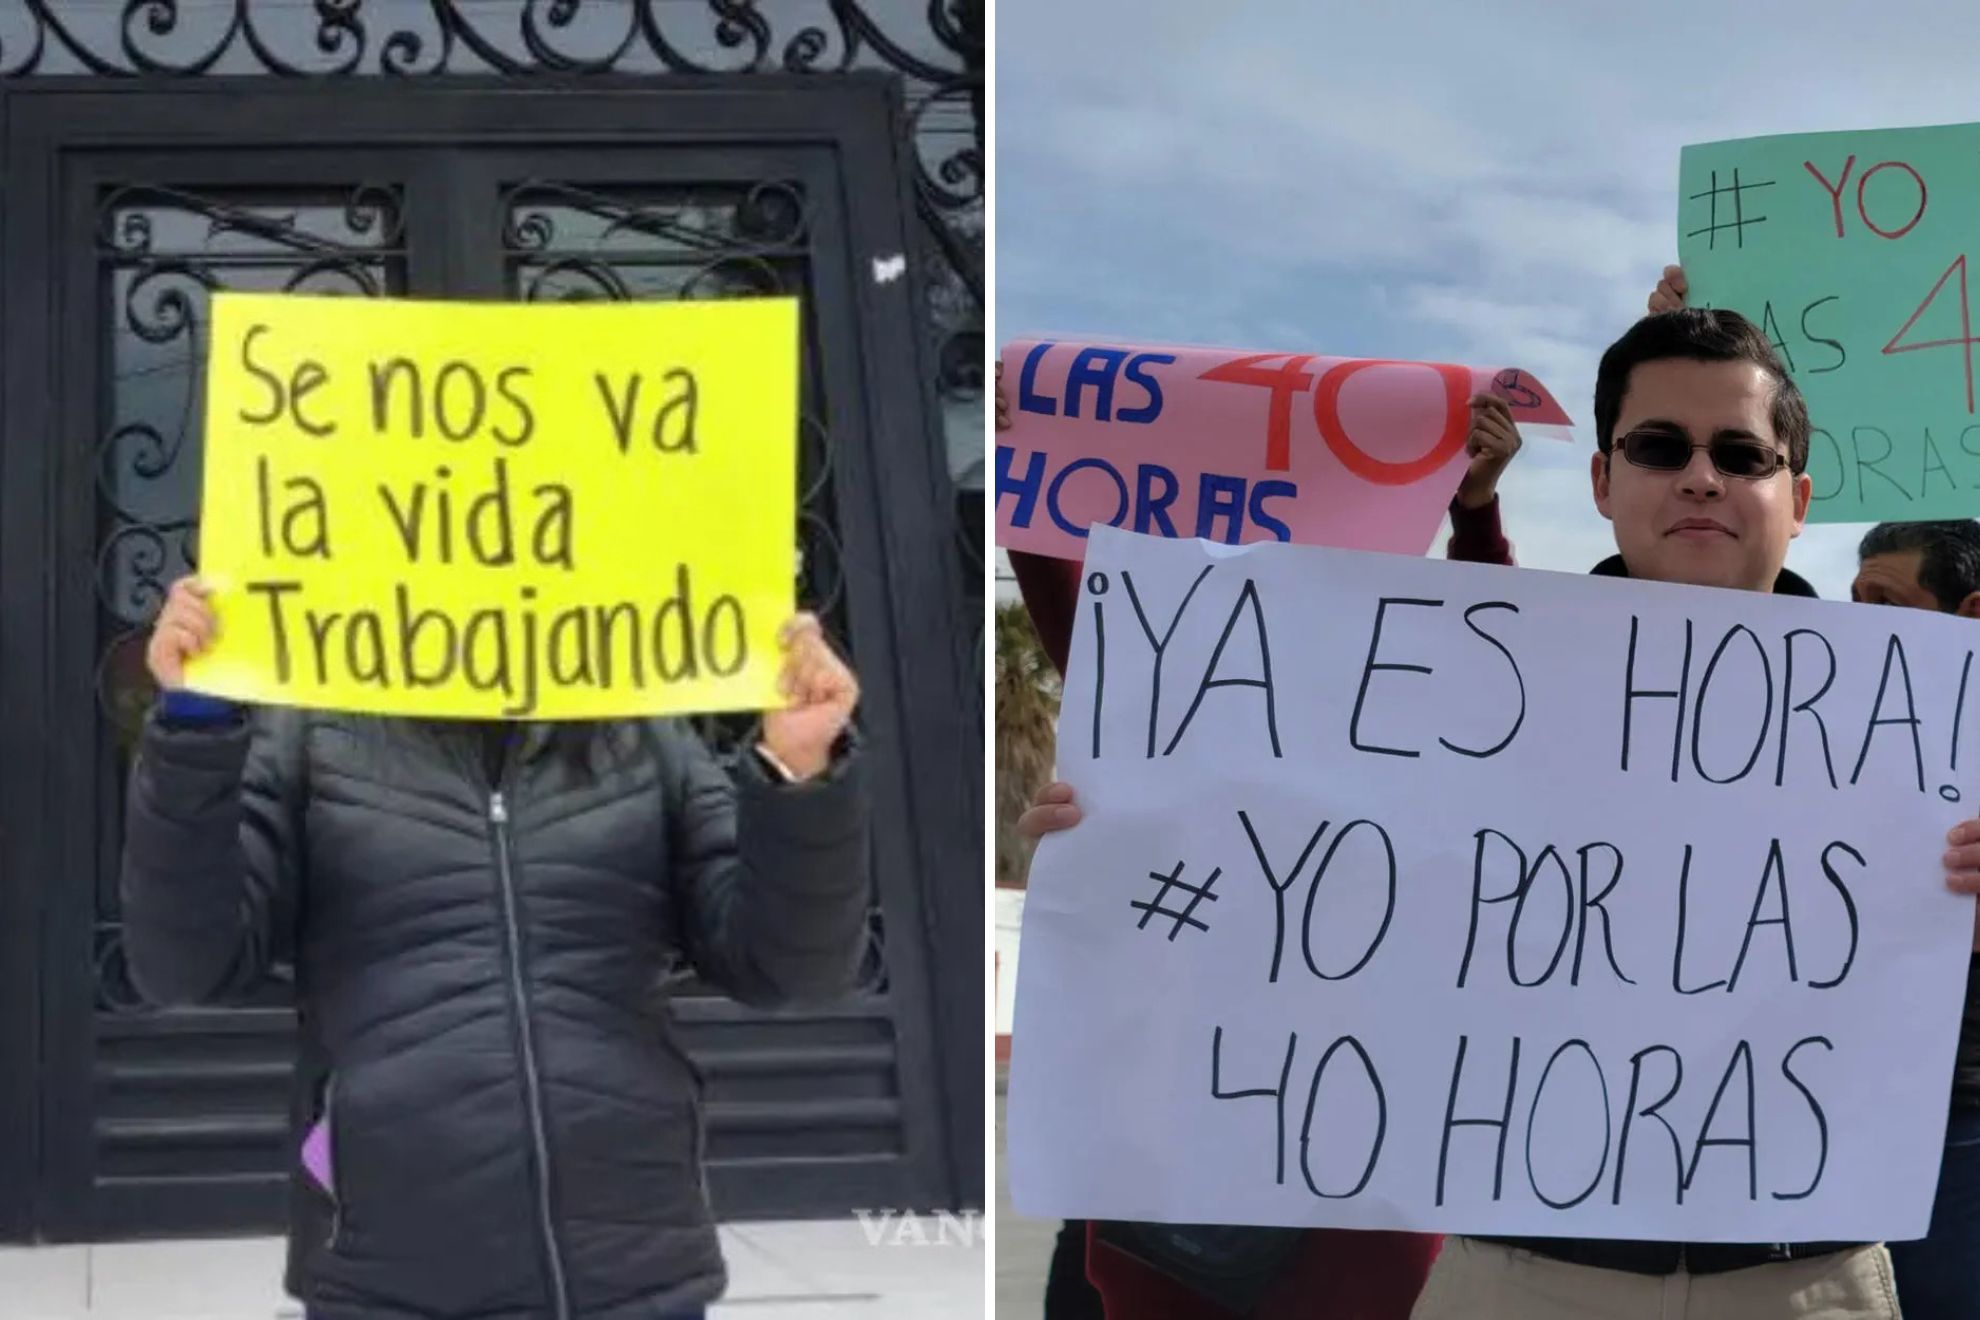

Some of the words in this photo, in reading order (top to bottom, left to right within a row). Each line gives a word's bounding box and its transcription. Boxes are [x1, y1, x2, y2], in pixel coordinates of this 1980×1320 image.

[1687, 168, 1776, 250] #
[1803, 154, 1927, 240] YO
[239, 323, 338, 438] Se
[367, 356, 536, 448] nos
[594, 366, 699, 457] va
[1705, 295, 1846, 374] AS
[1018, 343, 1176, 424] LAS
[1196, 353, 1472, 486] 40
[1808, 424, 1980, 503] ORA
[257, 454, 332, 560] la
[377, 456, 575, 571] vida
[995, 445, 1298, 546] HORAS
[245, 562, 748, 716] Trabajando
[1087, 564, 1283, 760] ¡YA
[1349, 596, 1526, 759] ES
[1620, 613, 1974, 803] HORA!
[1456, 828, 1637, 988] POR
[1672, 837, 1867, 996] LAS
[1210, 1025, 1387, 1199] 40
[1434, 1034, 1834, 1210] HORAS
